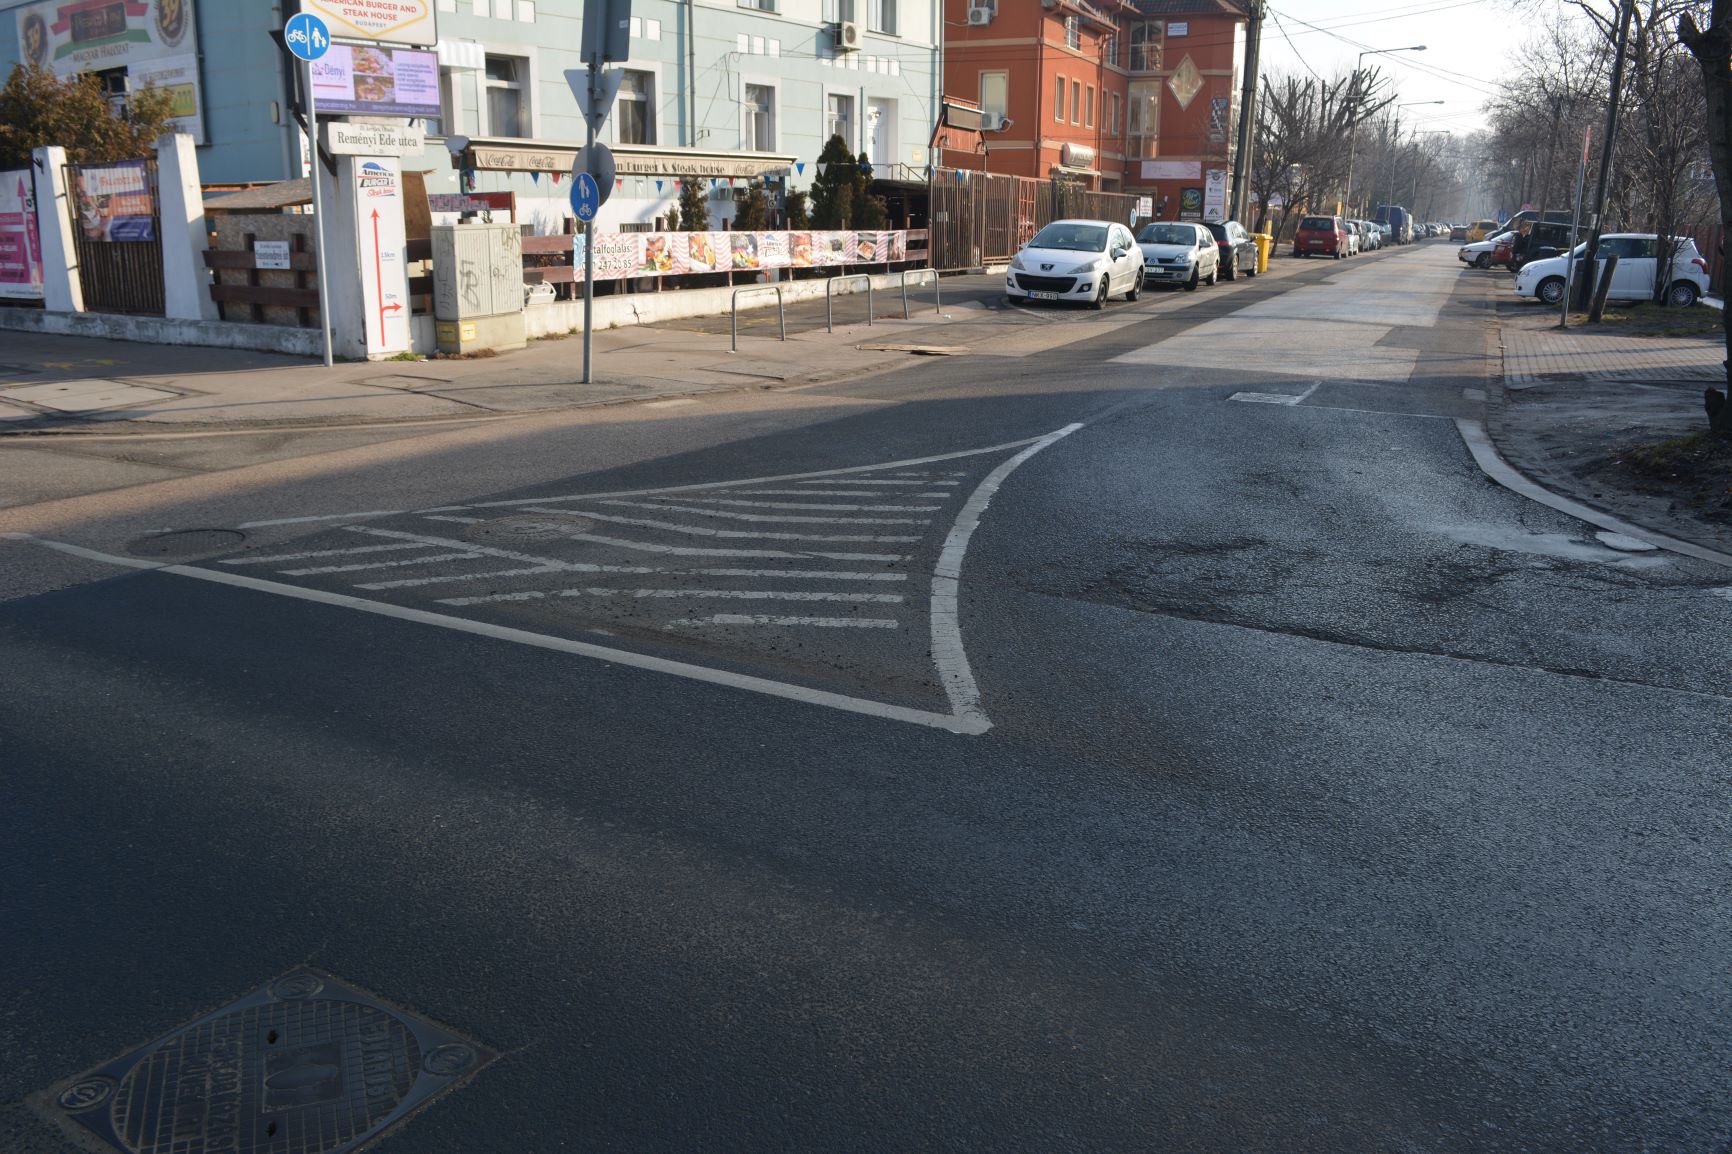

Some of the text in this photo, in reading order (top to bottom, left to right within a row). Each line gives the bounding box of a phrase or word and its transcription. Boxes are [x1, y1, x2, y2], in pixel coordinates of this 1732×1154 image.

[366, 1, 398, 10] BURGER
[400, 5, 417, 13] AND
[343, 8, 399, 21] STEAK HOUSE
[355, 20, 387, 28] BUDAPEST
[337, 131, 417, 147] Reményi Ede utca
[626, 161, 659, 173] Burger
[672, 161, 697, 174] Steak
[699, 162, 725, 174] house
